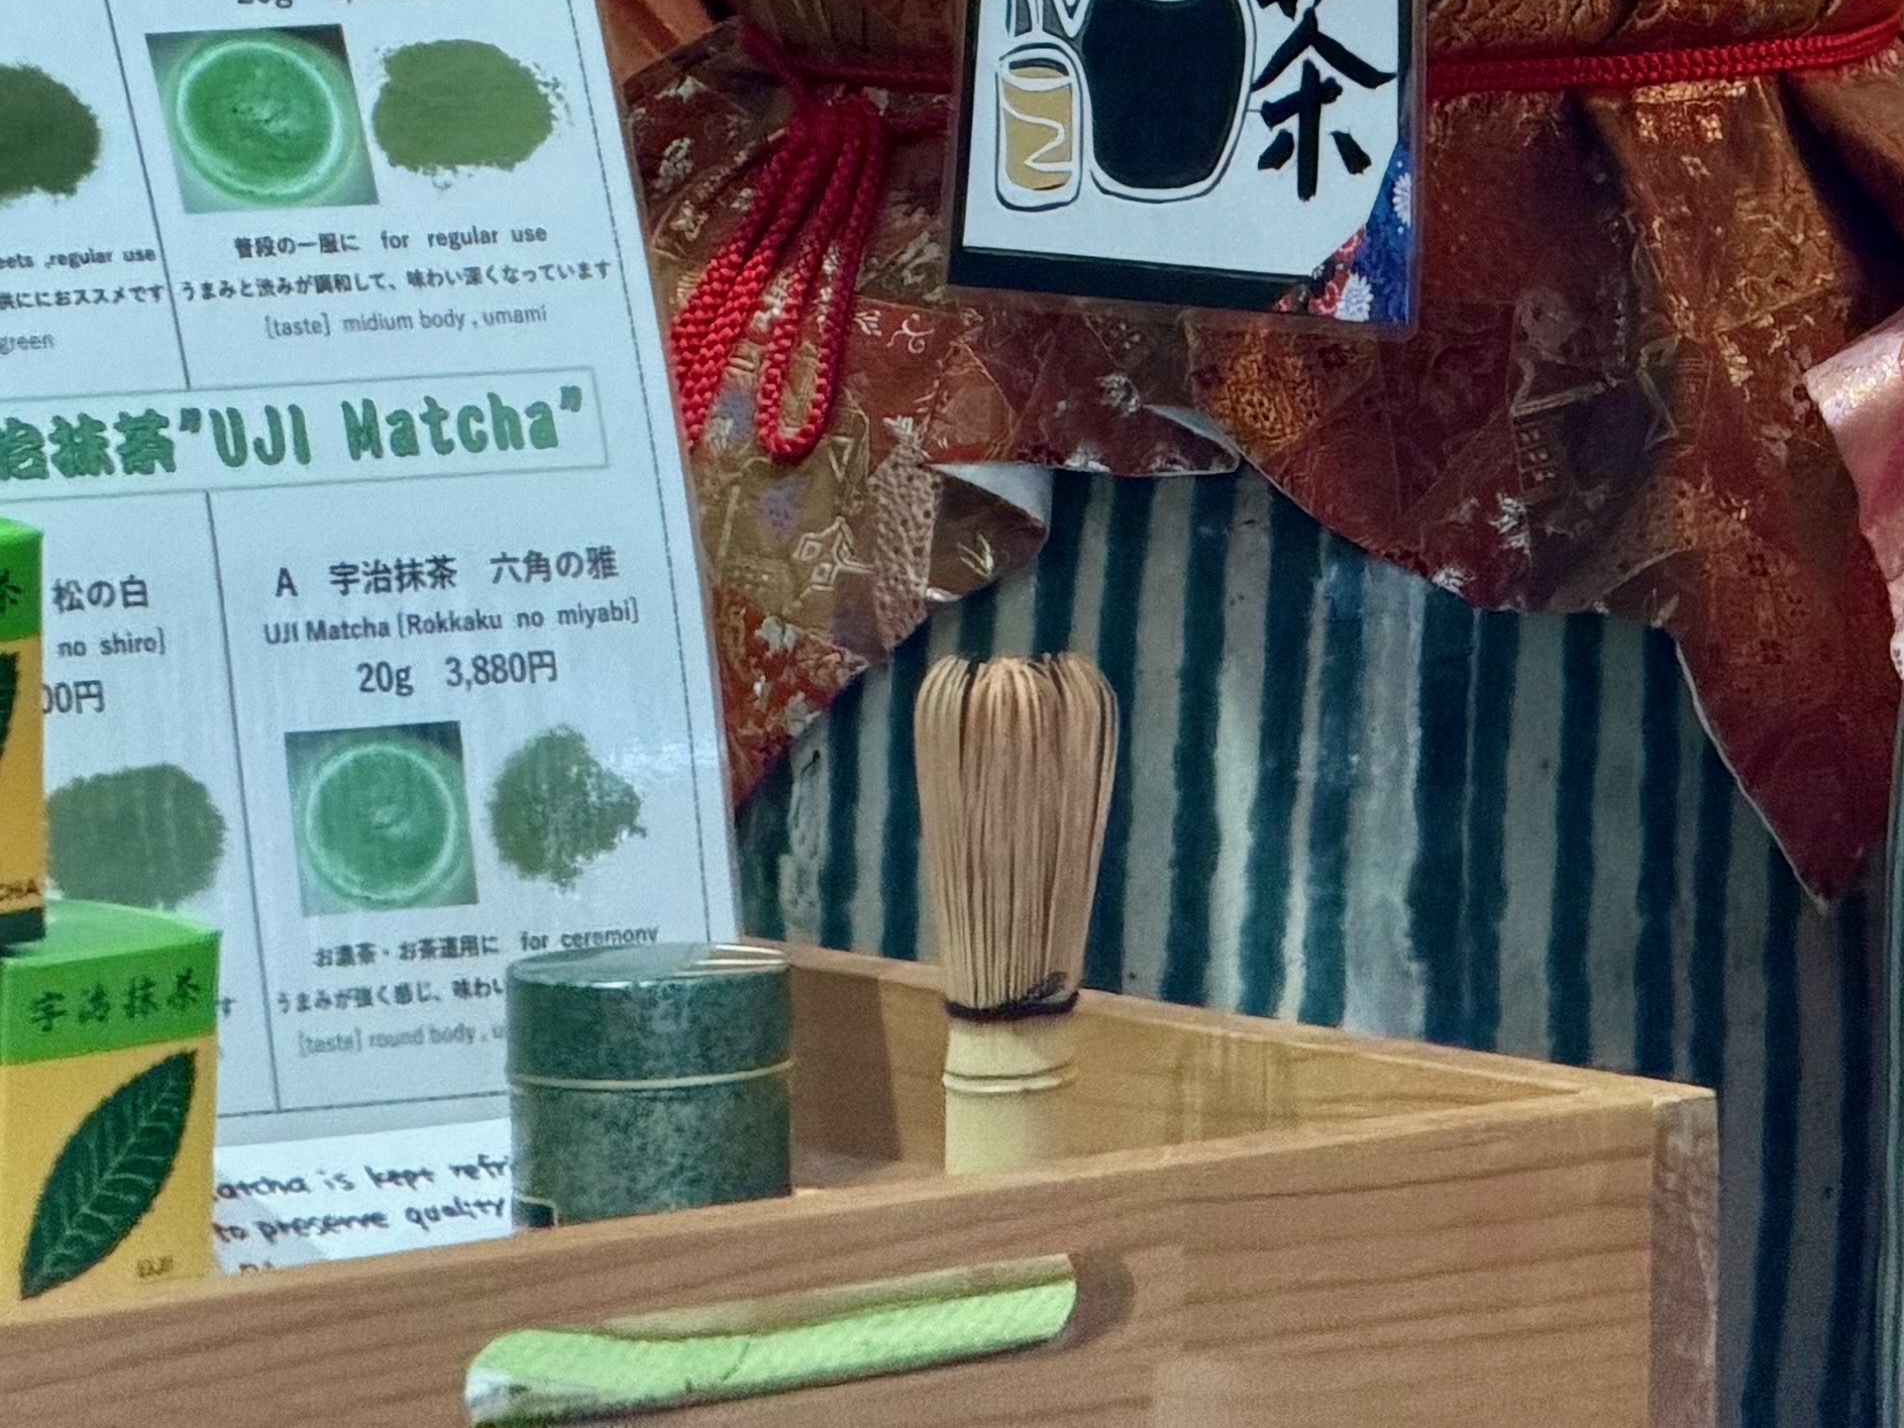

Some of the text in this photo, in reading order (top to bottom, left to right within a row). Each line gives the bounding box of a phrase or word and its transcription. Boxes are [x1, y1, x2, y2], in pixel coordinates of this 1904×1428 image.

[123, 249, 157, 262] use
[233, 225, 548, 258] 普段の一服に for regular use
[265, 312, 332, 338] [taste]
[419, 305, 465, 333] body
[482, 304, 548, 328] umami
[274, 545, 620, 600] A 宇治抹茶 六角の雅
[52, 574, 151, 614] 松の白
[263, 596, 640, 646] UJI Matcha [Rokkaku no miyabi]
[57, 628, 167, 660] no shiro]
[356, 649, 559, 698] 20g 3,880円
[519, 929, 548, 953] for
[365, 1164, 436, 1197] kept
[405, 1197, 507, 1232] quality
